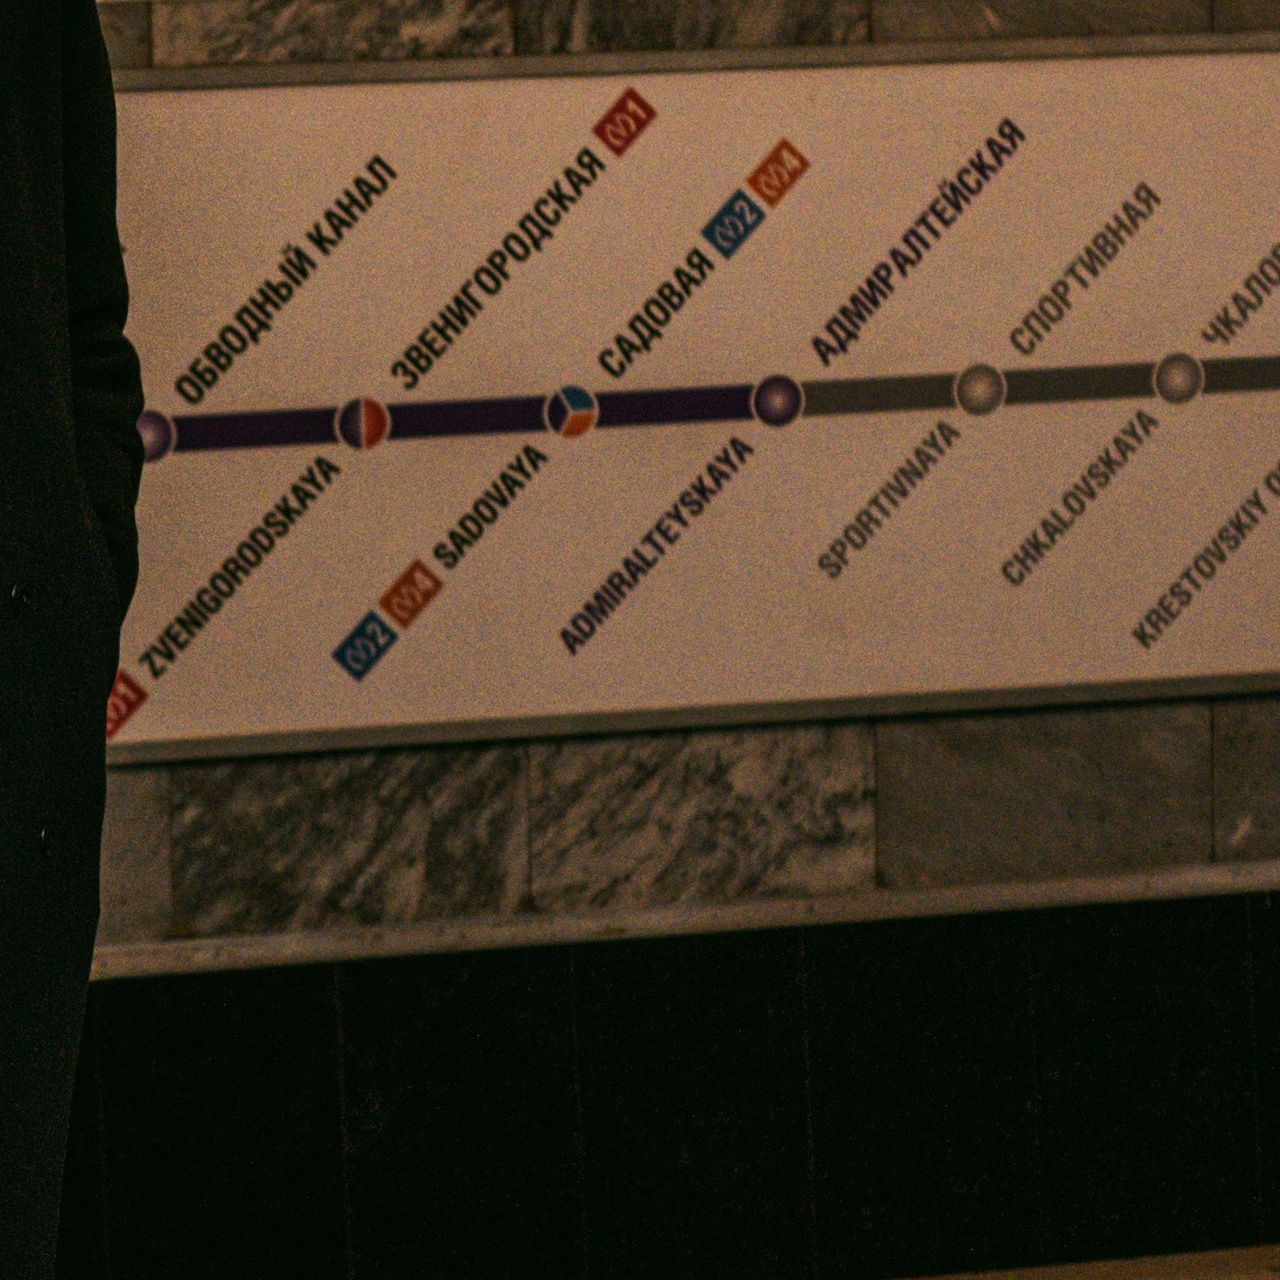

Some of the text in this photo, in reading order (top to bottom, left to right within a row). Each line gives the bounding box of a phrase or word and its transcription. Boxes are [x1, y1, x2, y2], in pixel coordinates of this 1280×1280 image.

[174, 154, 399, 405] ОБВОДНЫЙ КАНАЛ
[391, 147, 606, 391] ЗВЕНИГОРОДСКАЯ
[596, 247, 716, 380] САДОВАЯ
[810, 118, 1027, 368] АДМИРАЛТЕЙСКАЯ
[1009, 181, 1163, 357] СПОРТИВНАЯ
[138, 456, 342, 680] ZVENIGORODSKAYA
[433, 445, 548, 569] SADOVAYA
[558, 436, 755, 656] ADMIRALTEYSKAYA
[818, 420, 962, 580] SPORTIVNAYA
[1001, 409, 1160, 587] CHKALOVSKAYA
[1131, 489, 1269, 651] KRESTOVSKIY
